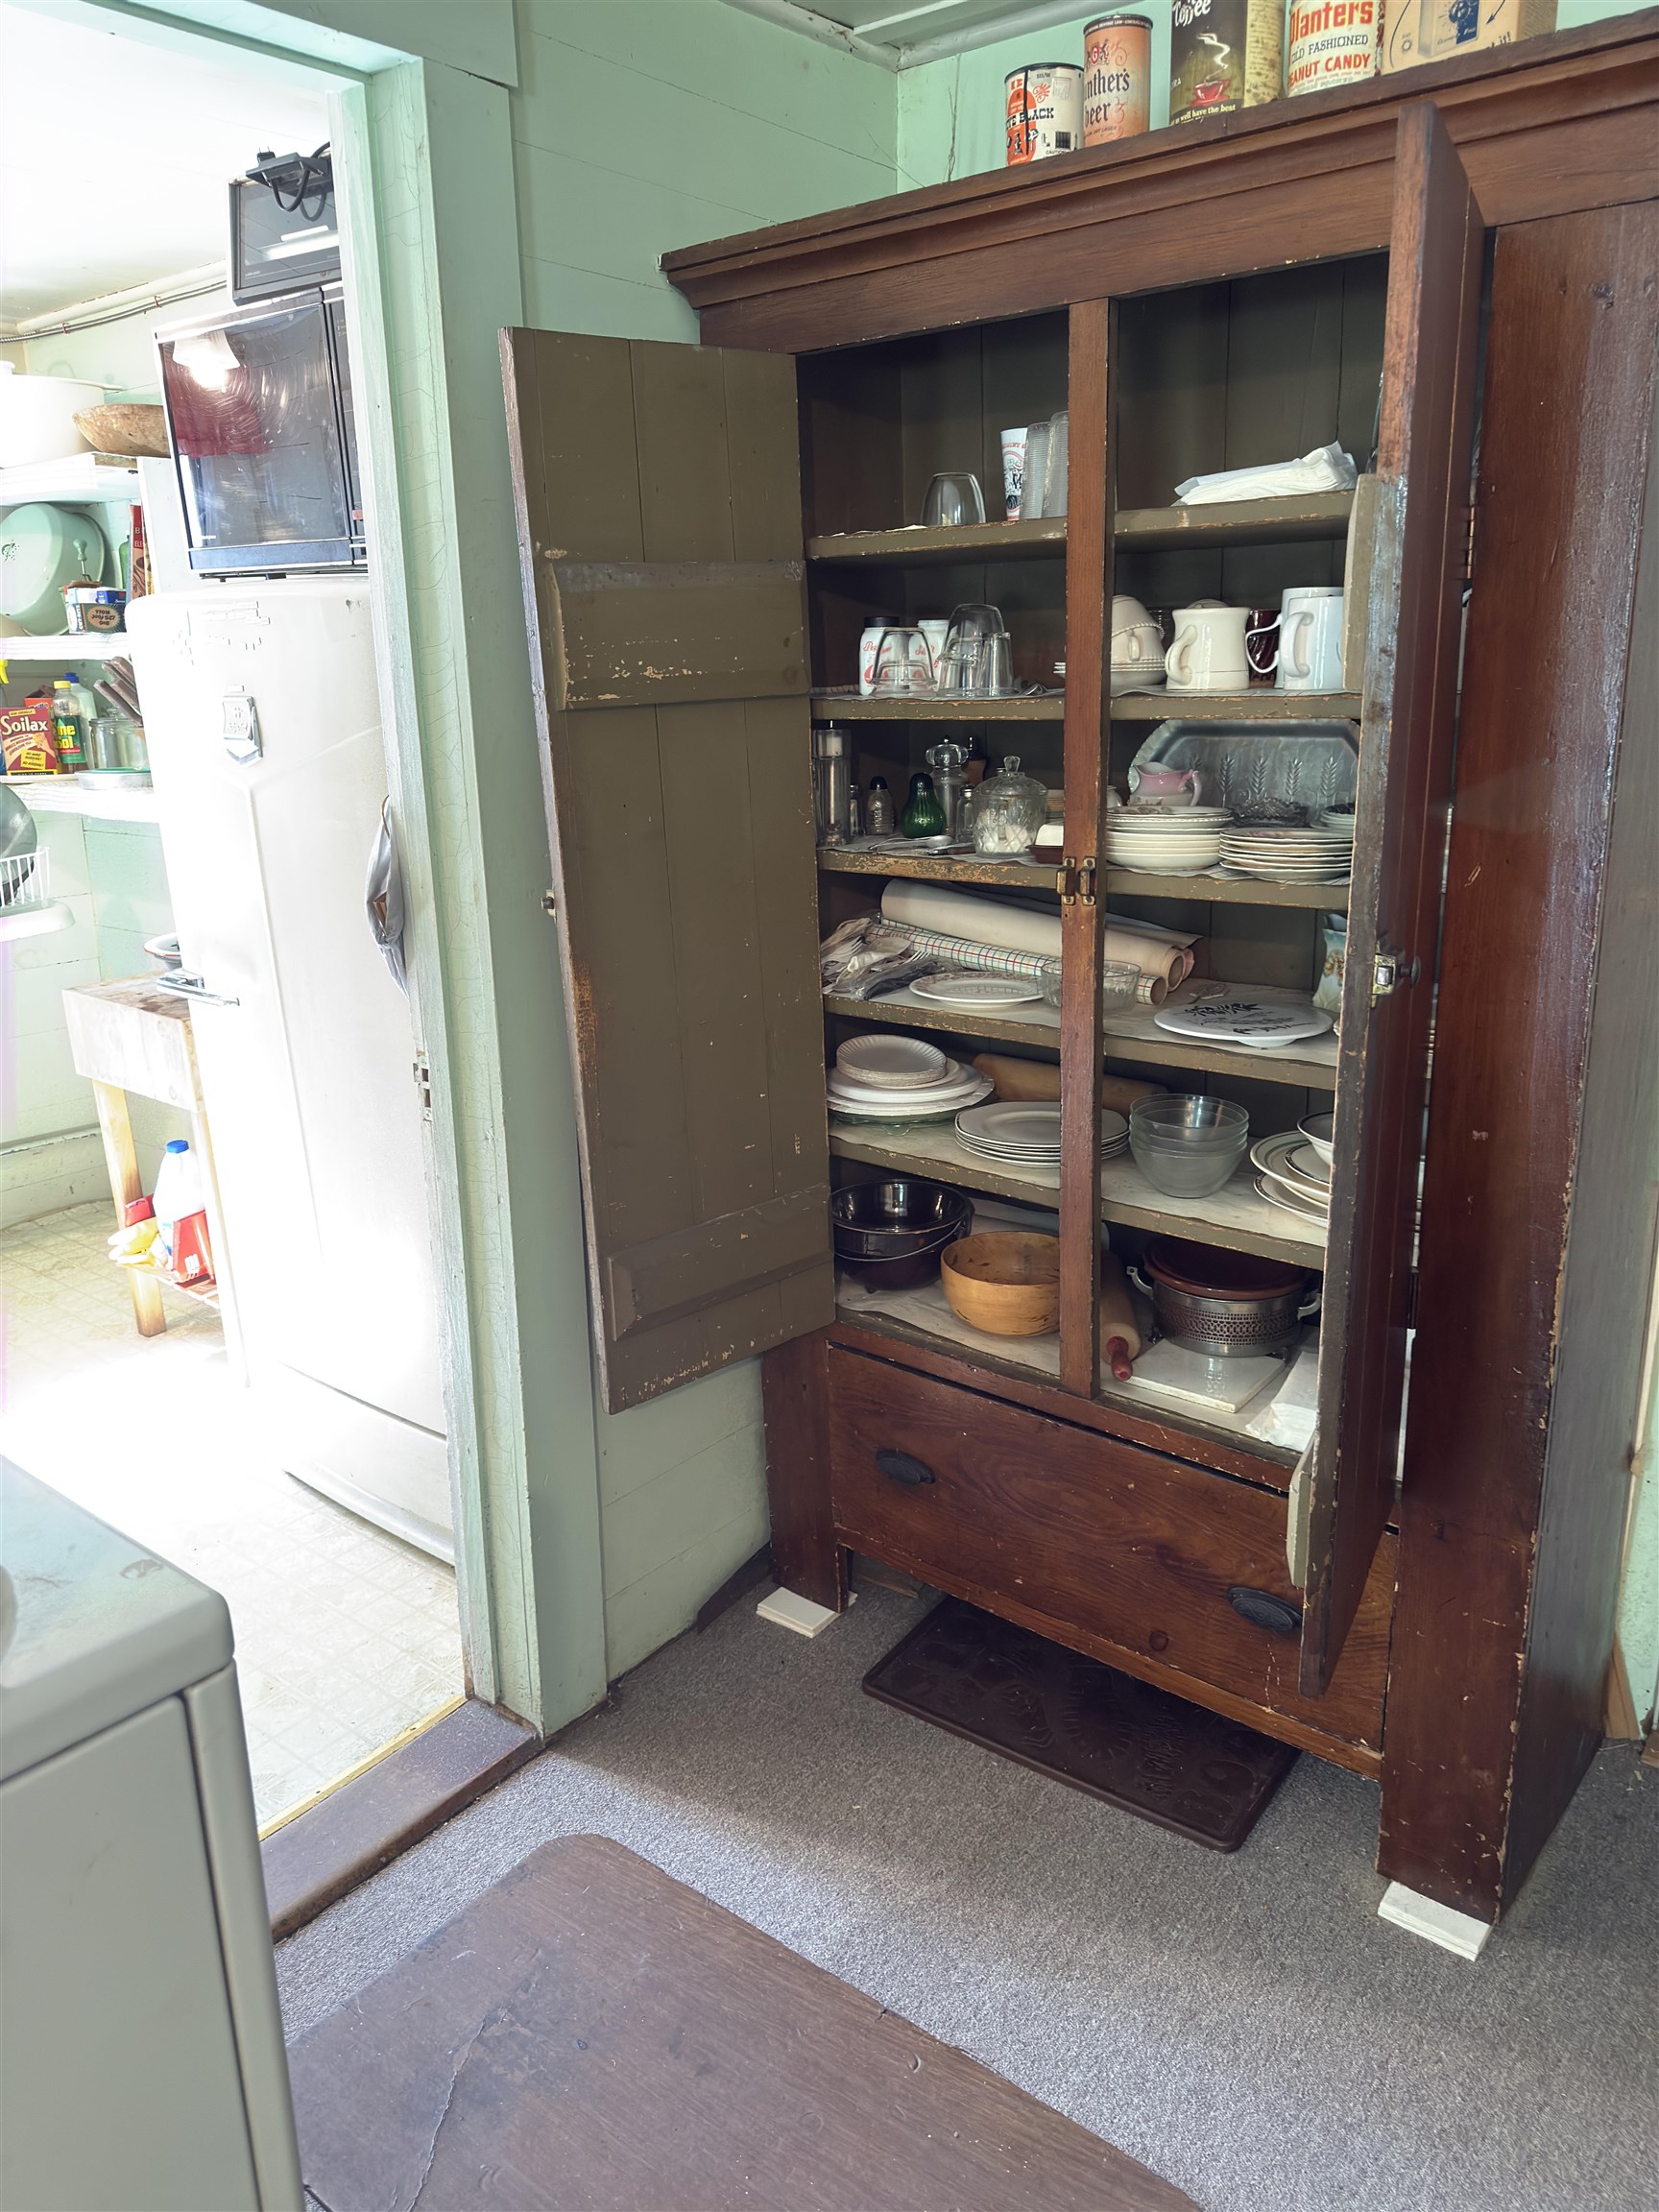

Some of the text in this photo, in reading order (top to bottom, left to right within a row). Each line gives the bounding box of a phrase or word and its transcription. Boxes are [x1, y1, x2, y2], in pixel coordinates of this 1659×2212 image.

[1172, 0, 1212, 27] Coffee
[1309, 35, 1368, 55] FASHIONED
[1289, 60, 1320, 87] EANUT
[1325, 54, 1371, 72] CANDY
[1086, 68, 1130, 100] nther's
[1220, 104, 1236, 112] best
[0, 715, 49, 735] Soilax
